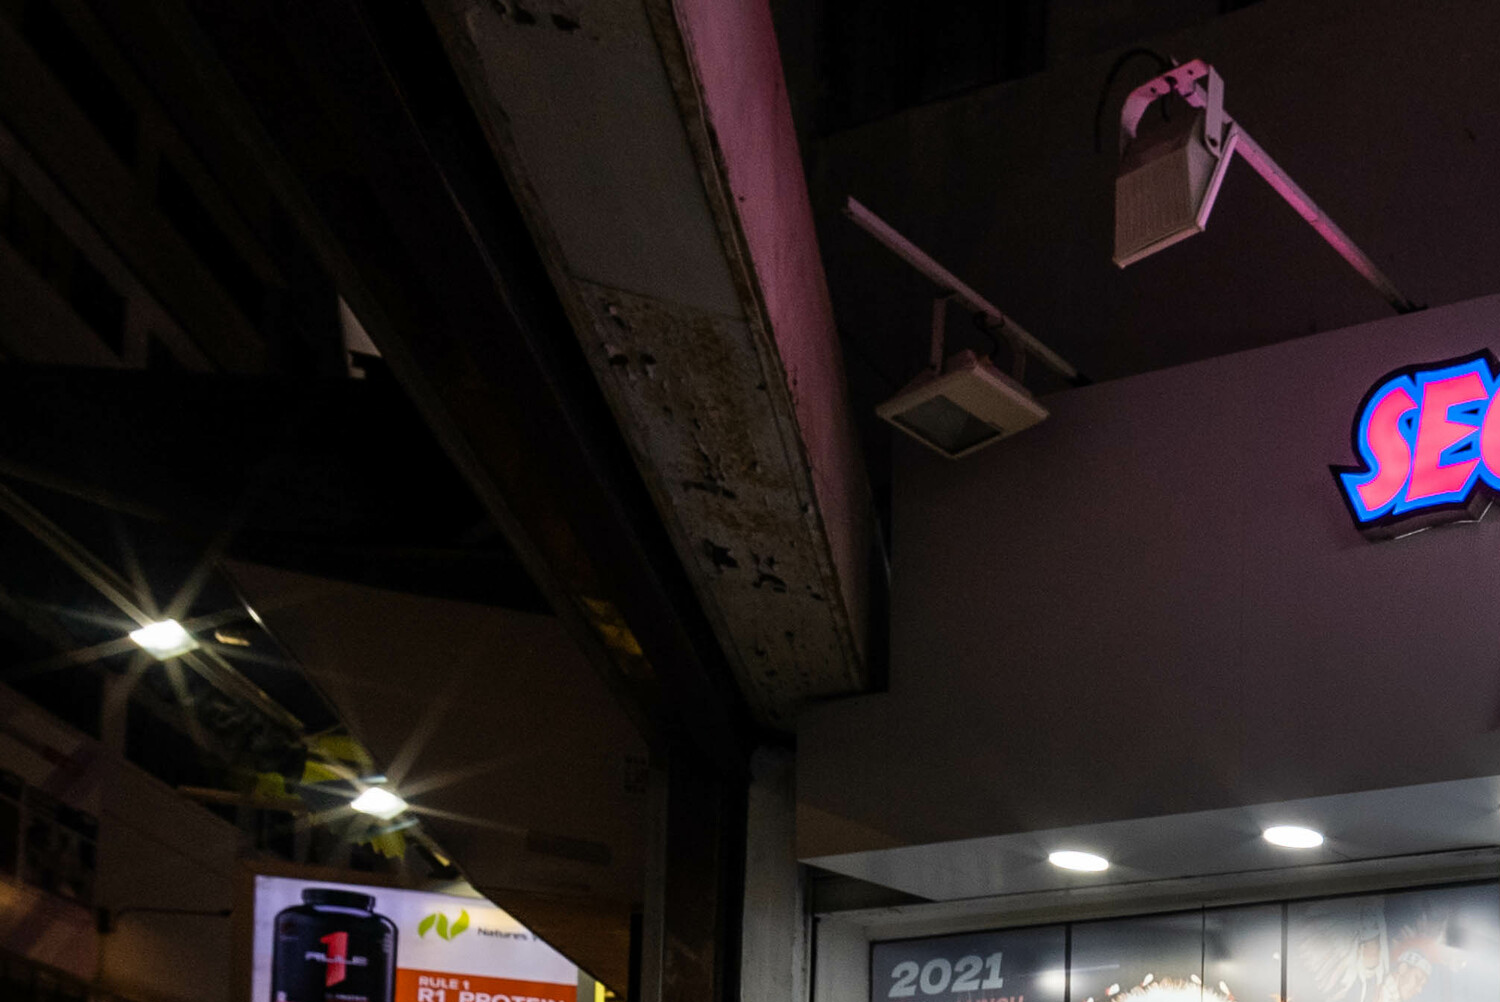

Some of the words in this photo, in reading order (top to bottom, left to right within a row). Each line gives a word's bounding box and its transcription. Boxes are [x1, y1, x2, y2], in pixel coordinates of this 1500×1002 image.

[419, 976, 459, 990] RULE
[462, 980, 470, 991] 1
[888, 952, 1003, 997] 2021
